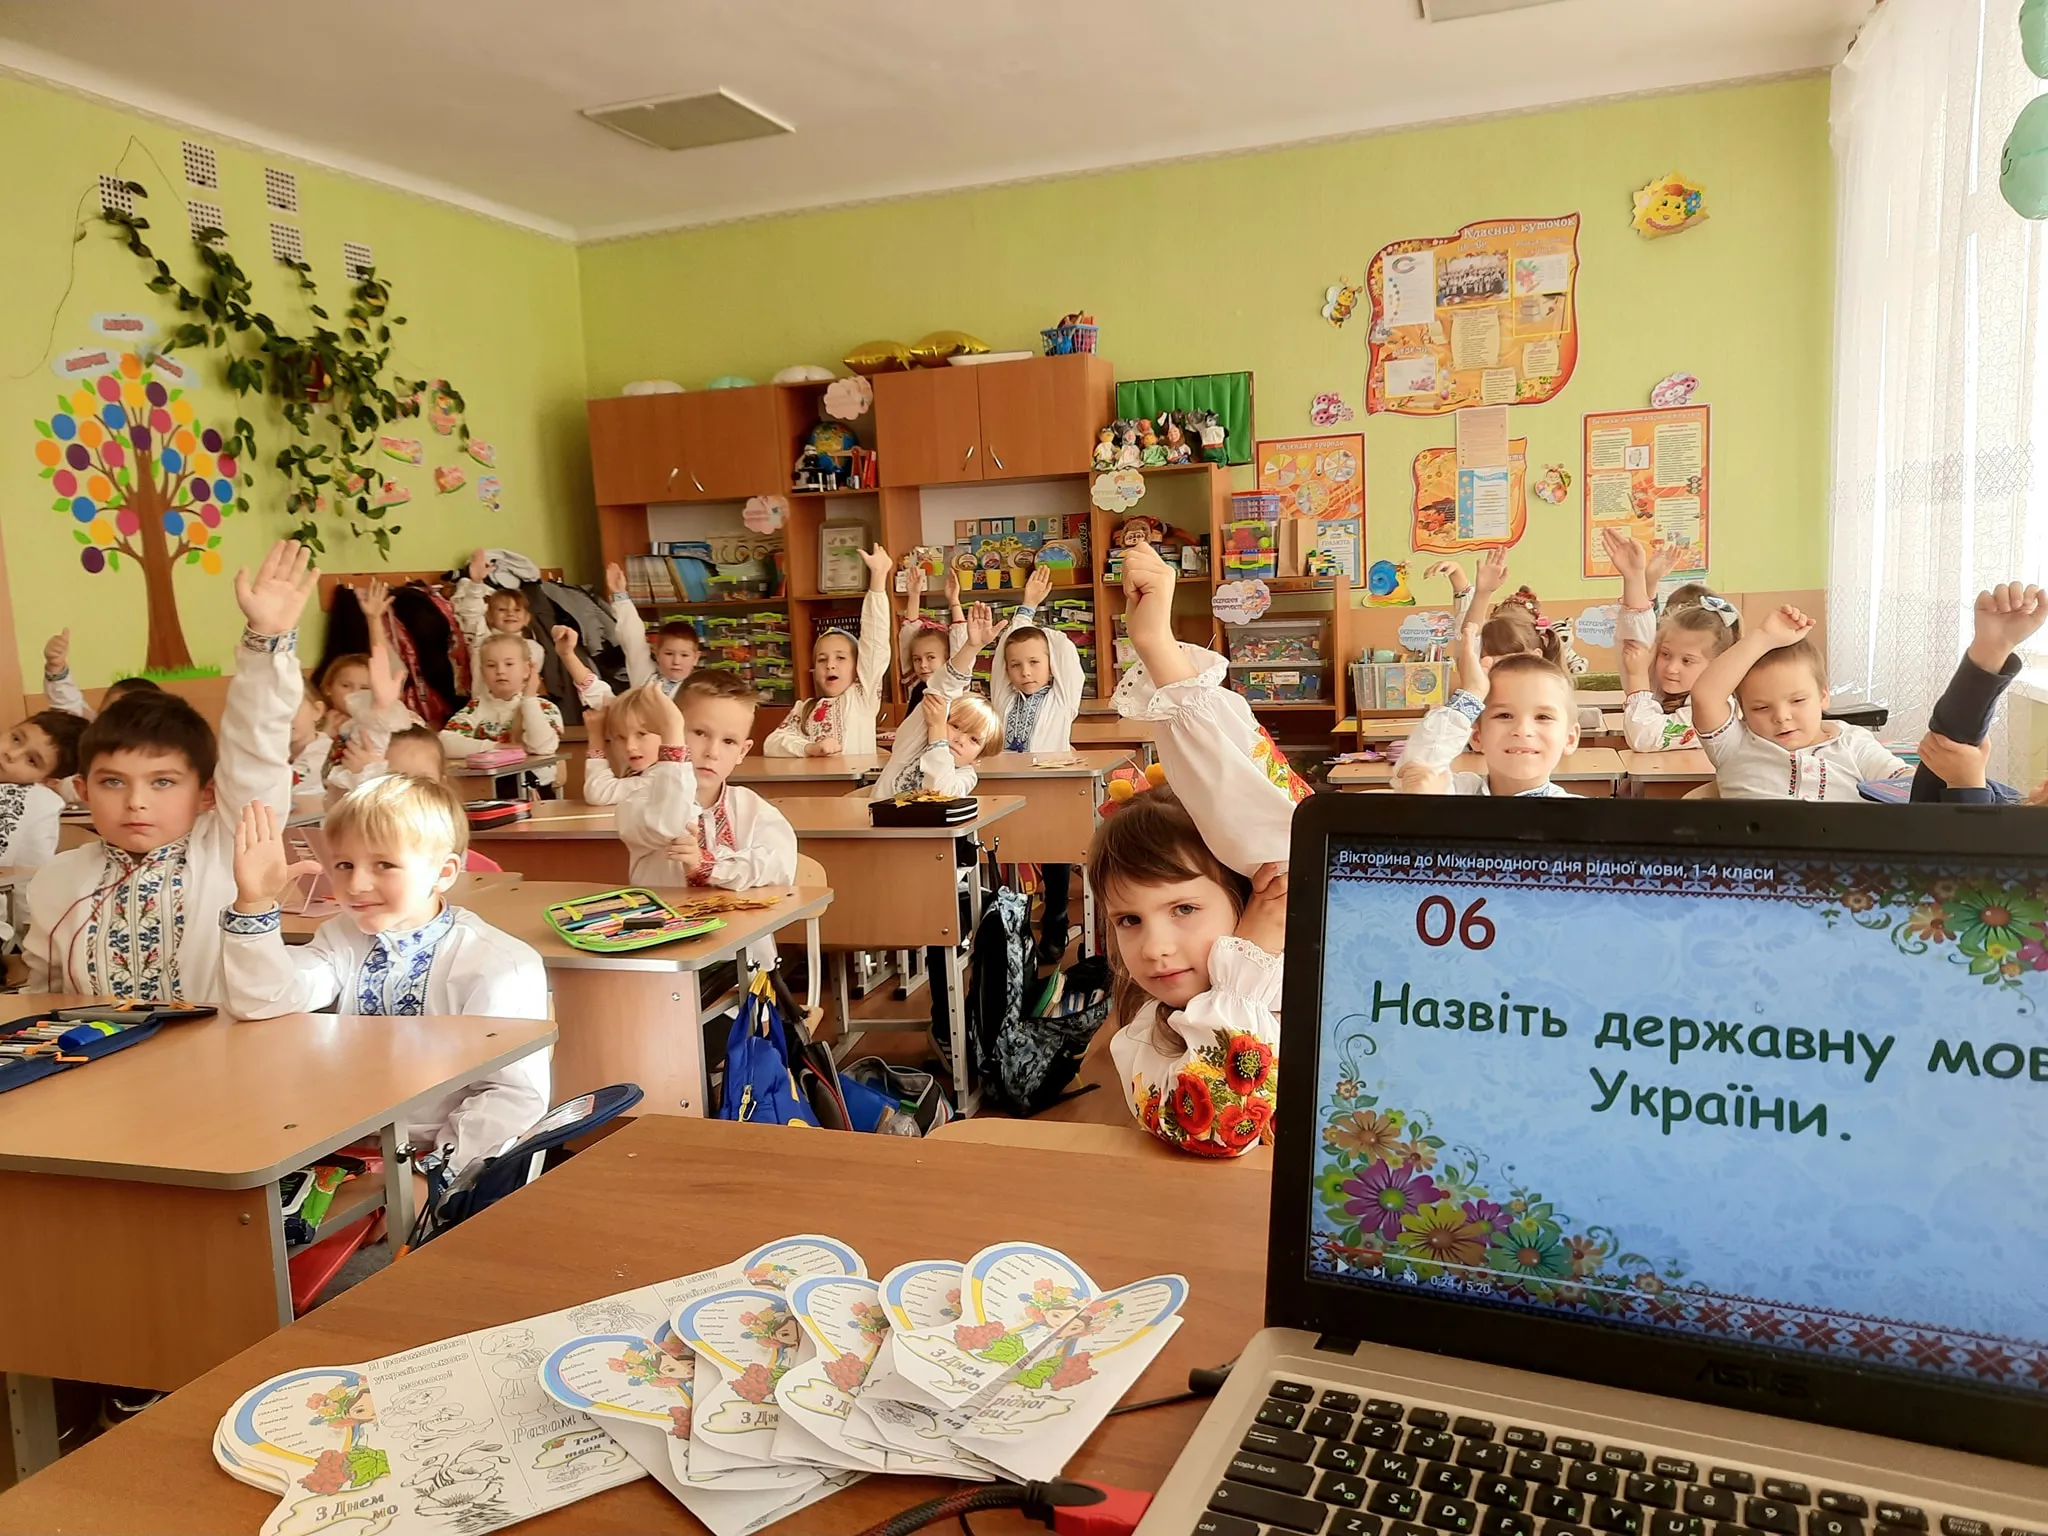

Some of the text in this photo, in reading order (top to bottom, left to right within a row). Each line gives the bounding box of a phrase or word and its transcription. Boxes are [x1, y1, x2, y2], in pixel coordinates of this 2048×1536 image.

[1339, 850, 1411, 867] Вікторина
[1414, 855, 1433, 868] до
[1551, 860, 1582, 874] дня
[1586, 859, 1637, 877] рідної
[1639, 863, 1688, 879] мови,
[1692, 864, 1717, 879] 1-4
[1722, 866, 1775, 881] класи
[1415, 894, 1497, 951] 06
[1370, 979, 1568, 1039] Назвіть
[1593, 1011, 1896, 1082] державну
[1589, 1066, 1853, 1142] України.
[1466, 1281, 1491, 1295] 5:20
[943, 1355, 986, 1379] Днем
[1282, 1384, 1300, 1394] esc
[740, 1411, 752, 1424] З
[512, 1413, 577, 1445] Разом
[573, 1430, 606, 1446] Твоя
[564, 1443, 601, 1459] твоя
[1257, 1462, 1278, 1475] lock
[315, 1491, 385, 1522] З Днем
[1198, 1521, 1217, 1532] ctrl
